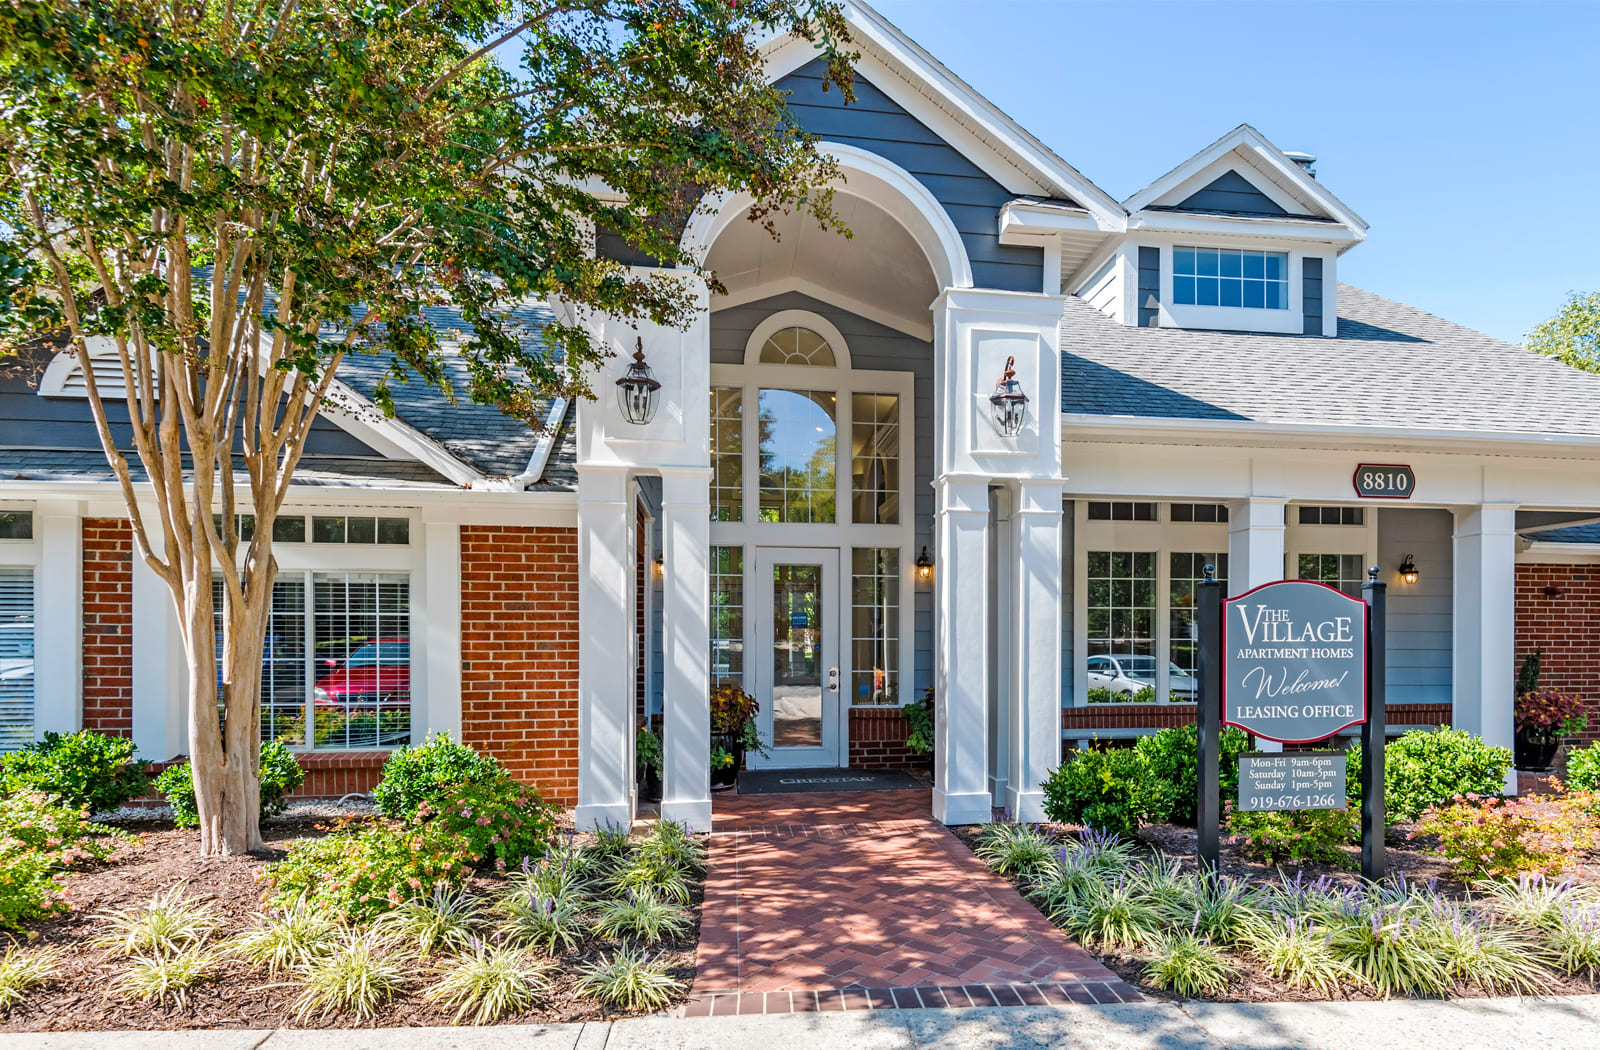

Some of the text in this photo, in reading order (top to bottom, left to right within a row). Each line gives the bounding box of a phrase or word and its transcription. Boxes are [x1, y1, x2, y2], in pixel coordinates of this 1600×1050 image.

[1363, 472, 1407, 491] 8810
[1262, 609, 1289, 622] THE
[1236, 604, 1353, 645] VILLAGE
[1237, 648, 1353, 659] APARTMENT HOMES
[1241, 666, 1349, 699] Welcome!
[1237, 705, 1354, 719] LEASING OFFICE
[1250, 757, 1332, 768] Mon-Fri 9am-6pm
[1249, 768, 1336, 780] Saturday 10am-5pm
[1255, 779, 1332, 791] Sunday 1pm-5pm
[1250, 794, 1335, 809] 919-676-1266
